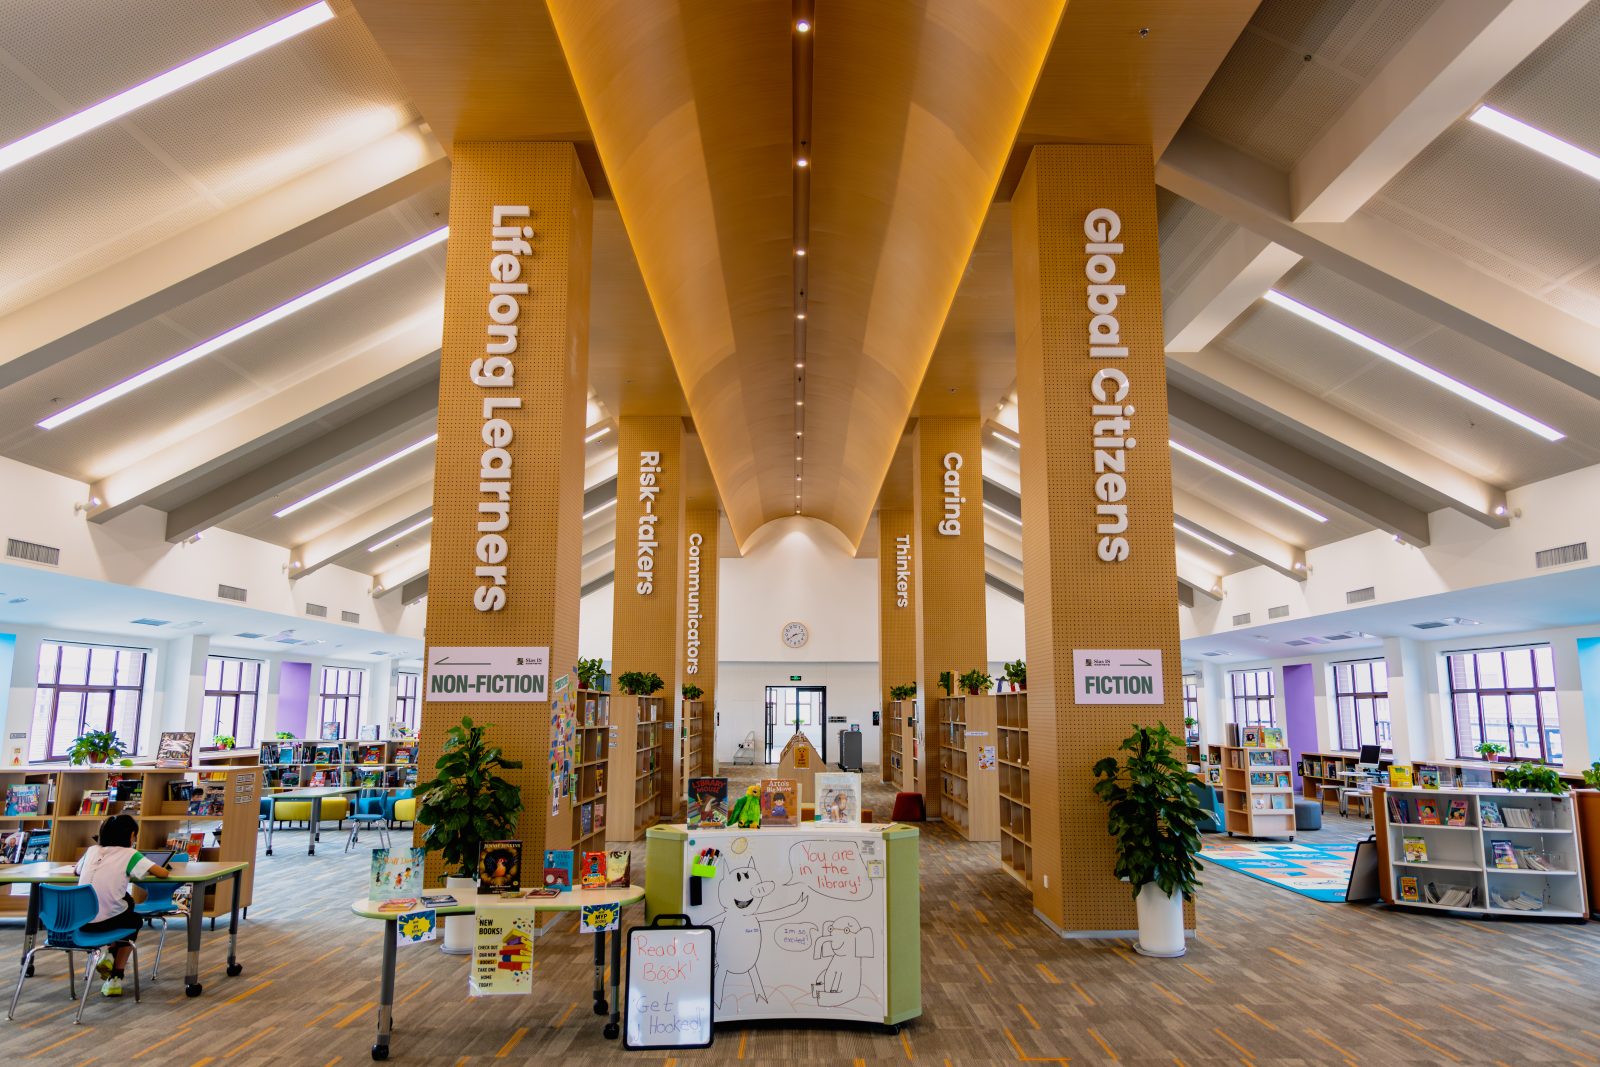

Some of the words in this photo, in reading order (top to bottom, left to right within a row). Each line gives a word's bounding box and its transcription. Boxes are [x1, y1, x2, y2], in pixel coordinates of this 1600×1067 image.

[1083, 207, 1129, 358] Global
[469, 204, 535, 388] Lifelong
[1090, 367, 1137, 563] Citizens
[473, 396, 523, 613] Learners
[937, 452, 967, 536] Caring
[636, 451, 662, 596] Risk-takers
[896, 534, 912, 608] Thinkers
[686, 533, 703, 675] Communicators
[431, 674, 545, 694] NON-FICTION
[1085, 675, 1153, 695] FICTION
[691, 779, 726, 789] LIBRARY
[801, 843, 827, 863] You
[832, 849, 855, 861] are
[799, 865, 813, 876] in
[821, 863, 849, 875] the
[817, 875, 861, 894] library!
[478, 927, 503, 935] BOOKS!
[479, 919, 494, 927] NEW
[634, 935, 677, 957] Read
[635, 991, 673, 1014] Get
